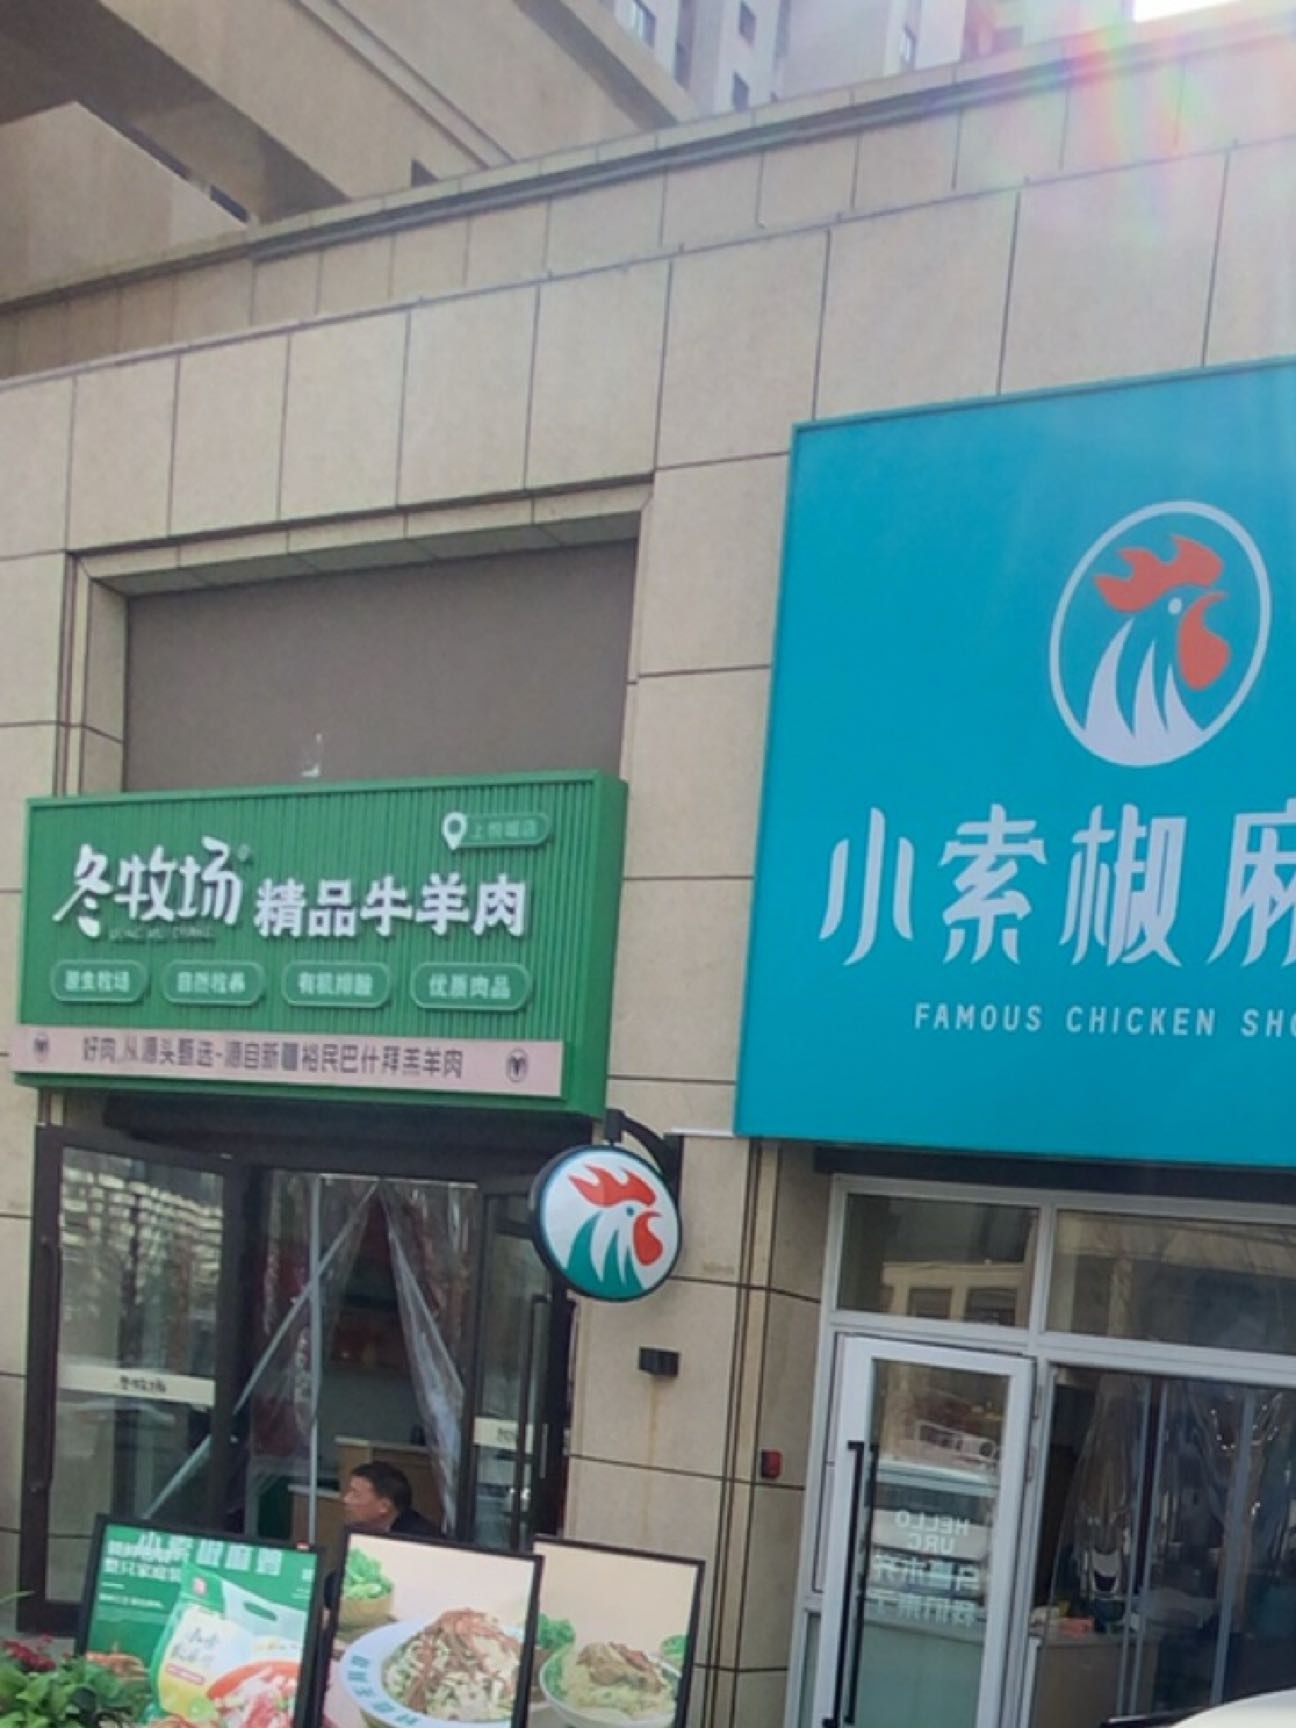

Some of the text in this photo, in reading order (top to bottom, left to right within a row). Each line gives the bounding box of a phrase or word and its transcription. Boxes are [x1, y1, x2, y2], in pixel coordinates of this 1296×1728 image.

[53, 836, 244, 938] 冬牧场
[253, 873, 527, 937] 精品牛羊肉
[914, 1003, 1043, 1034] FAMOUS
[1066, 1006, 1216, 1037] CHICKEN
